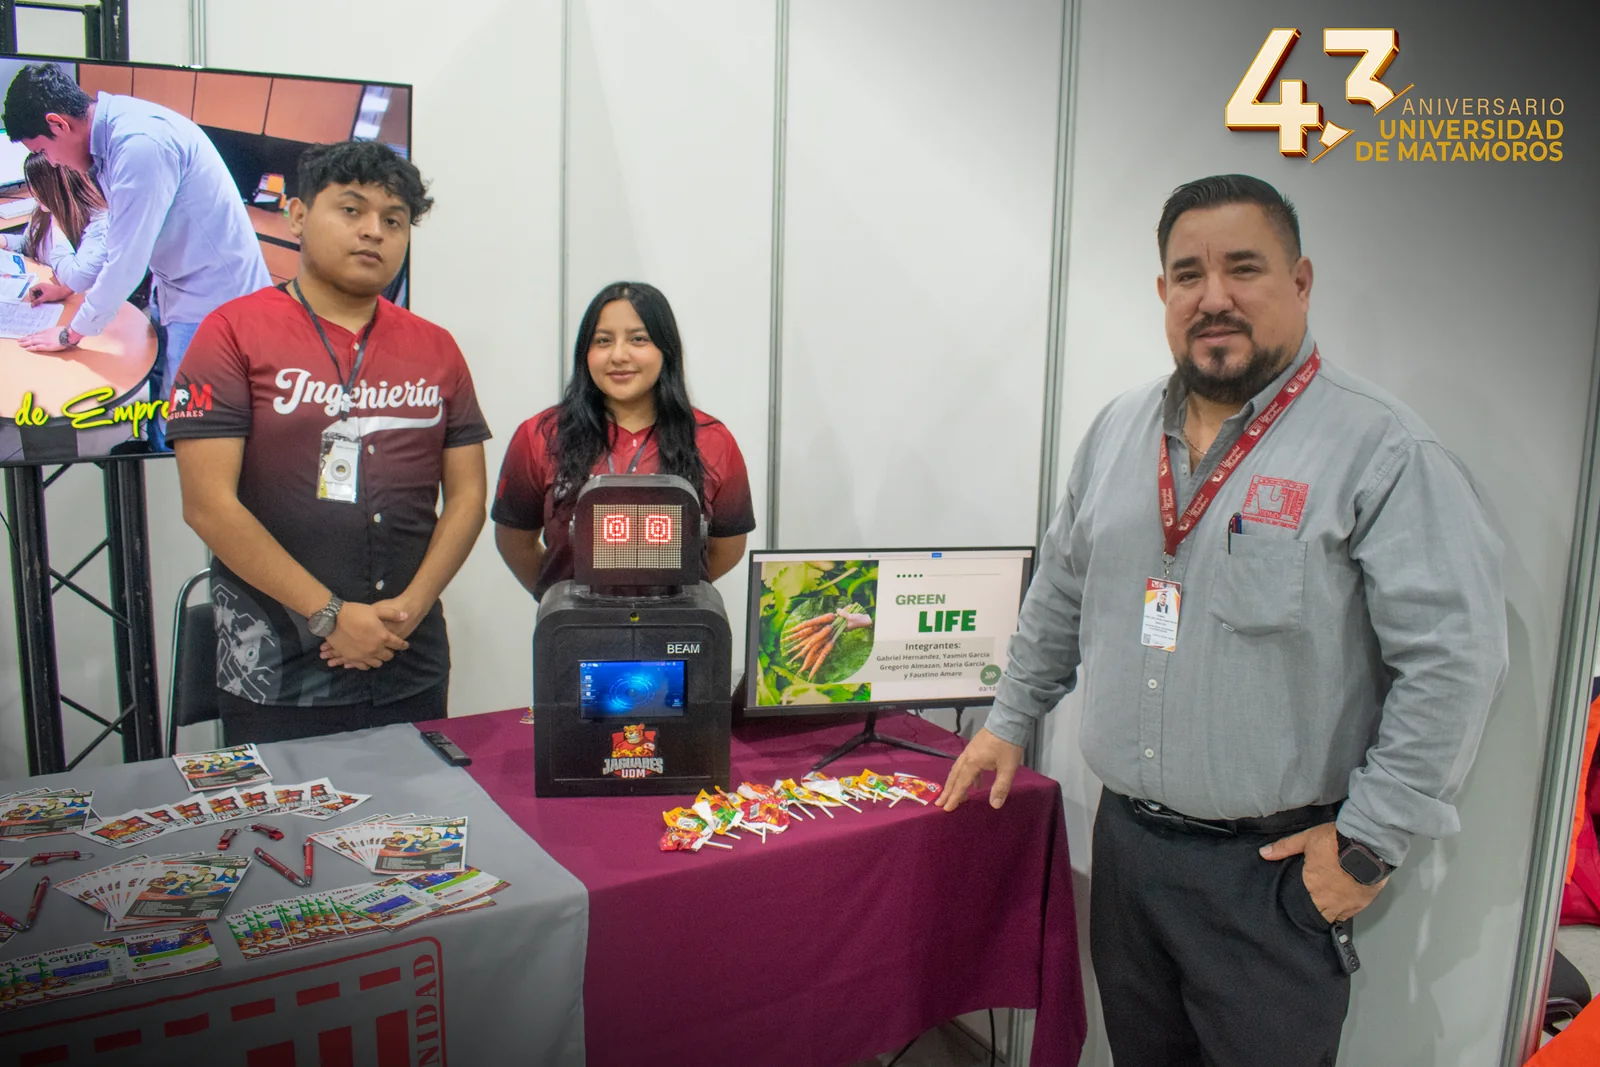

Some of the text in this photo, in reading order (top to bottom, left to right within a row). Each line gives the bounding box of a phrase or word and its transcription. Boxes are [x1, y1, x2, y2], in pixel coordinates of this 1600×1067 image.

[14, 393, 49, 427] de
[895, 594, 946, 605] GREEN
[918, 610, 977, 633] LIFE
[667, 643, 700, 654] BEAM
[905, 642, 961, 652] Integrantes:
[602, 757, 664, 775] JAGUARES
[621, 768, 646, 779] UDM
